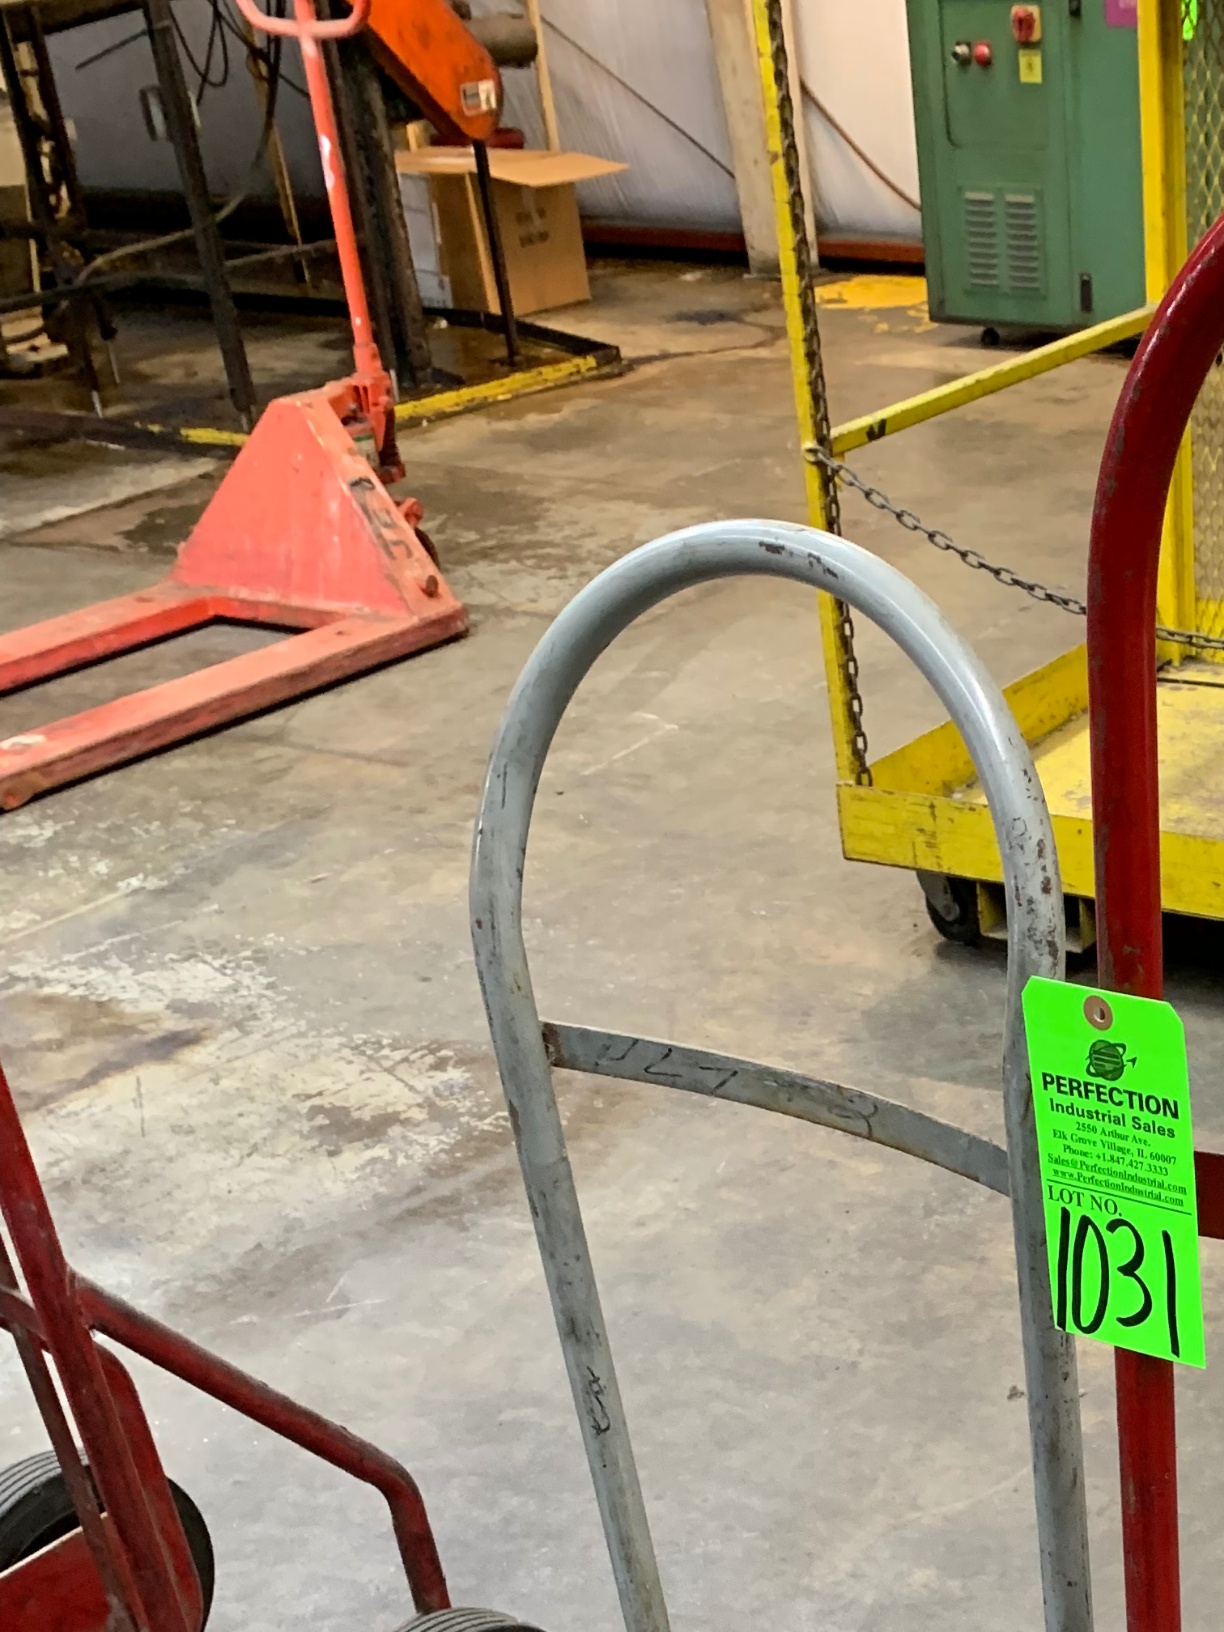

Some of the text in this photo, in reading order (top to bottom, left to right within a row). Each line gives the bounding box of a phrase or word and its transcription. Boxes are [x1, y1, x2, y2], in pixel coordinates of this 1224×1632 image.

[1041, 1072, 1179, 1120] PERFECTION
[1049, 1098, 1176, 1139] Industrial Sales
[1075, 1121, 1151, 1148] 2550 Arthur Ave.
[1052, 1128, 1177, 1165] Elk Grove Village, IL 60007
[1062, 1144, 1169, 1177] Phone: +1.847.427.3333
[1048, 1185, 1122, 1217] LOT NO.
[1052, 1168, 1184, 1207] www.PerfectionIndustrial.com
[1056, 1206, 1180, 1358] 1031
